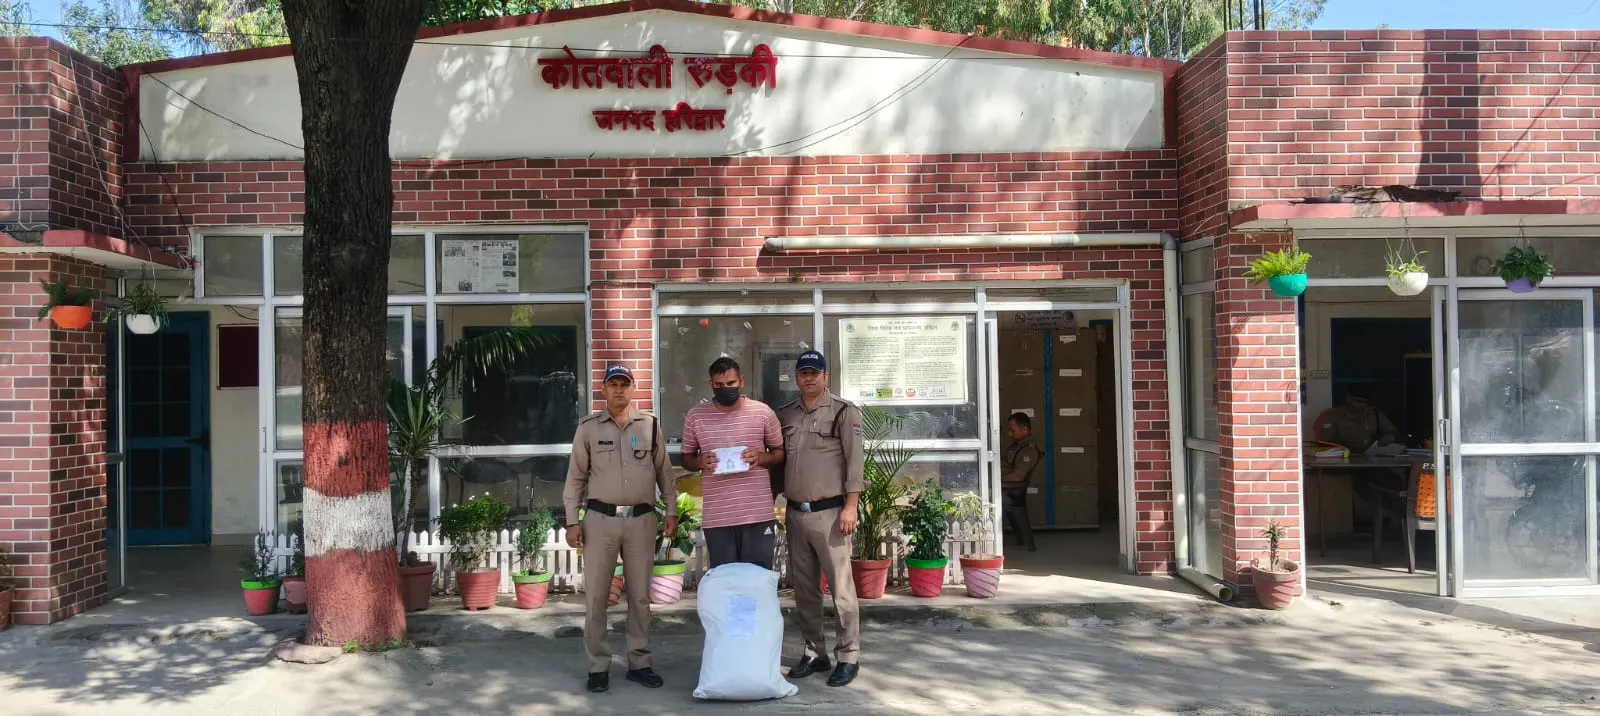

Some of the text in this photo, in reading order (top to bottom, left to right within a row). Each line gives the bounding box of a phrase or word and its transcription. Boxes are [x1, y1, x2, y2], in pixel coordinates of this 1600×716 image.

[537, 44, 777, 95] कोतवाली रुड़की
[592, 101, 727, 132] जनपद हरिद्वार
